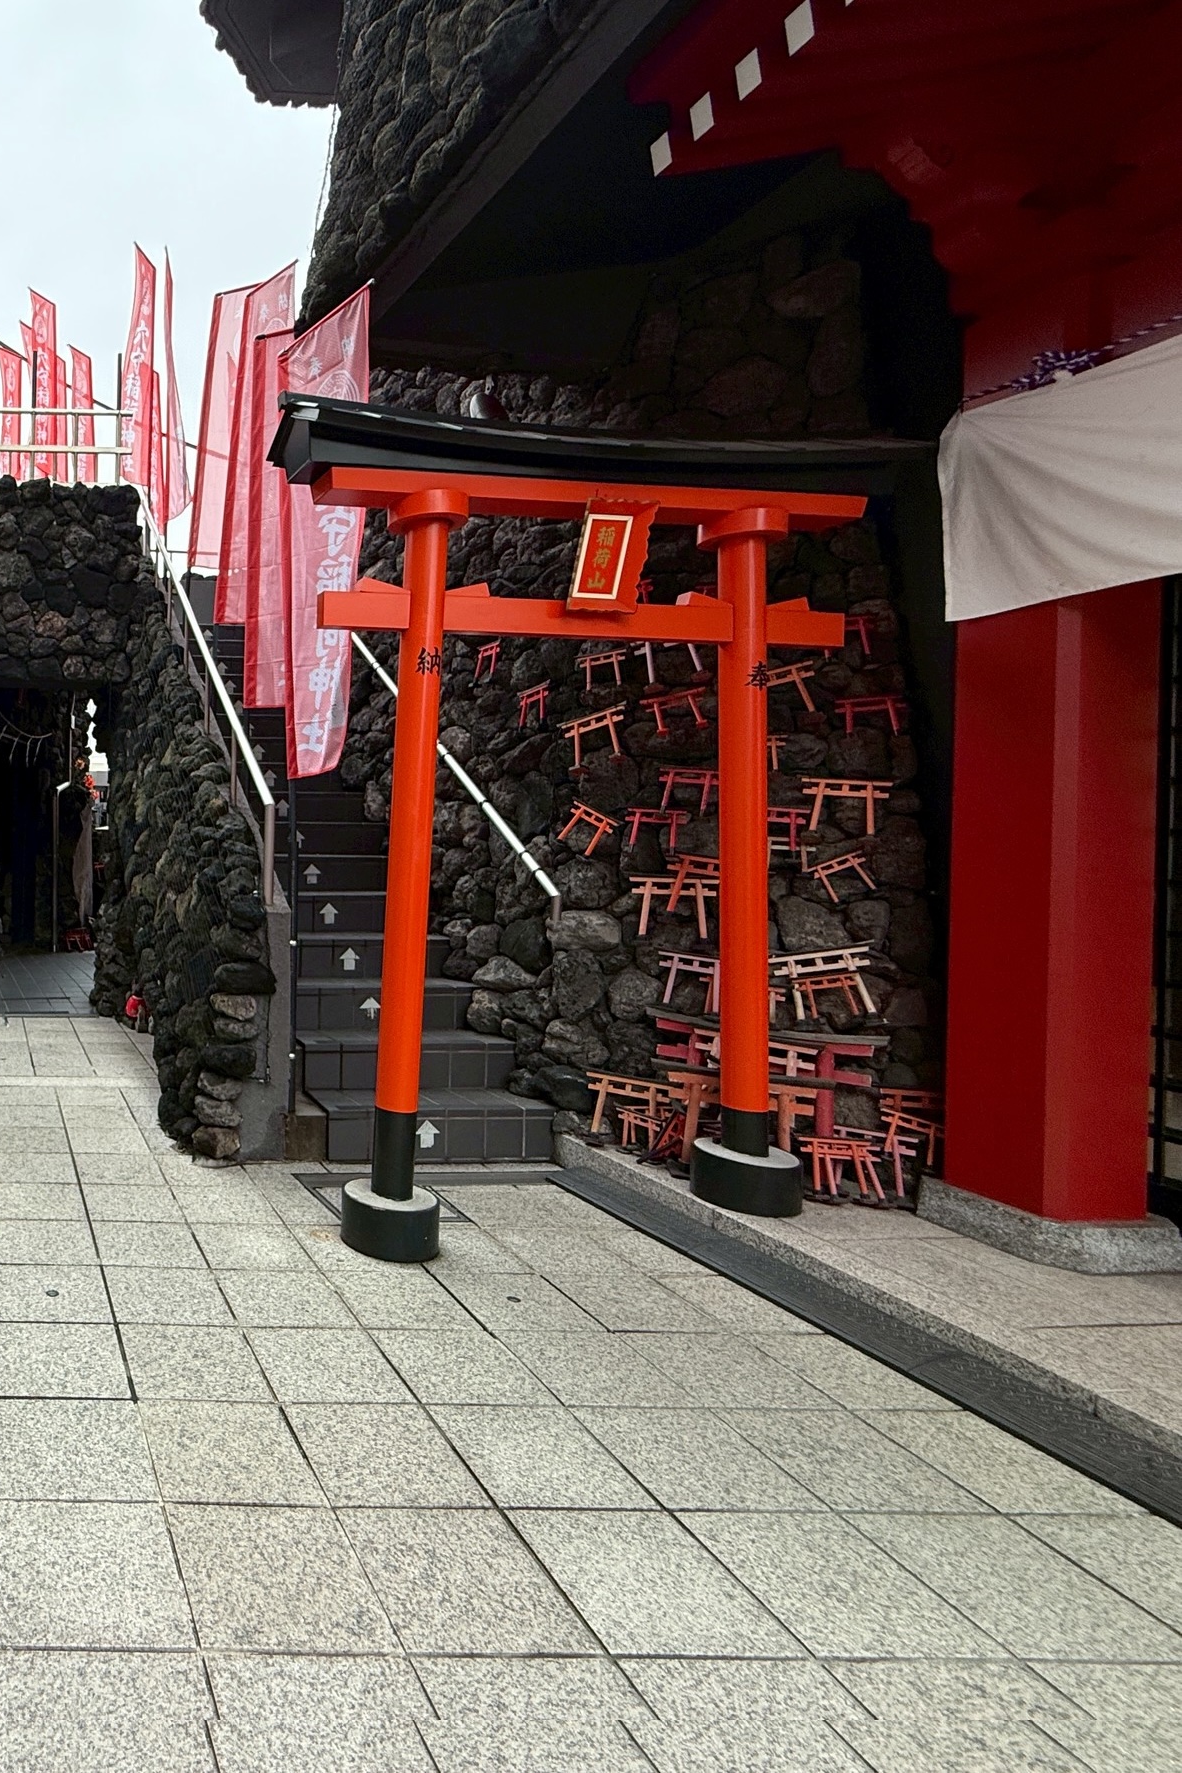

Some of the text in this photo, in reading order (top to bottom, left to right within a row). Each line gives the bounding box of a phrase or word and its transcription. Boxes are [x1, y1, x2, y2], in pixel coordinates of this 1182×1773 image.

[586, 525, 617, 591] 稲荷山
[415, 646, 442, 677] 納
[745, 660, 770, 690] 奉
